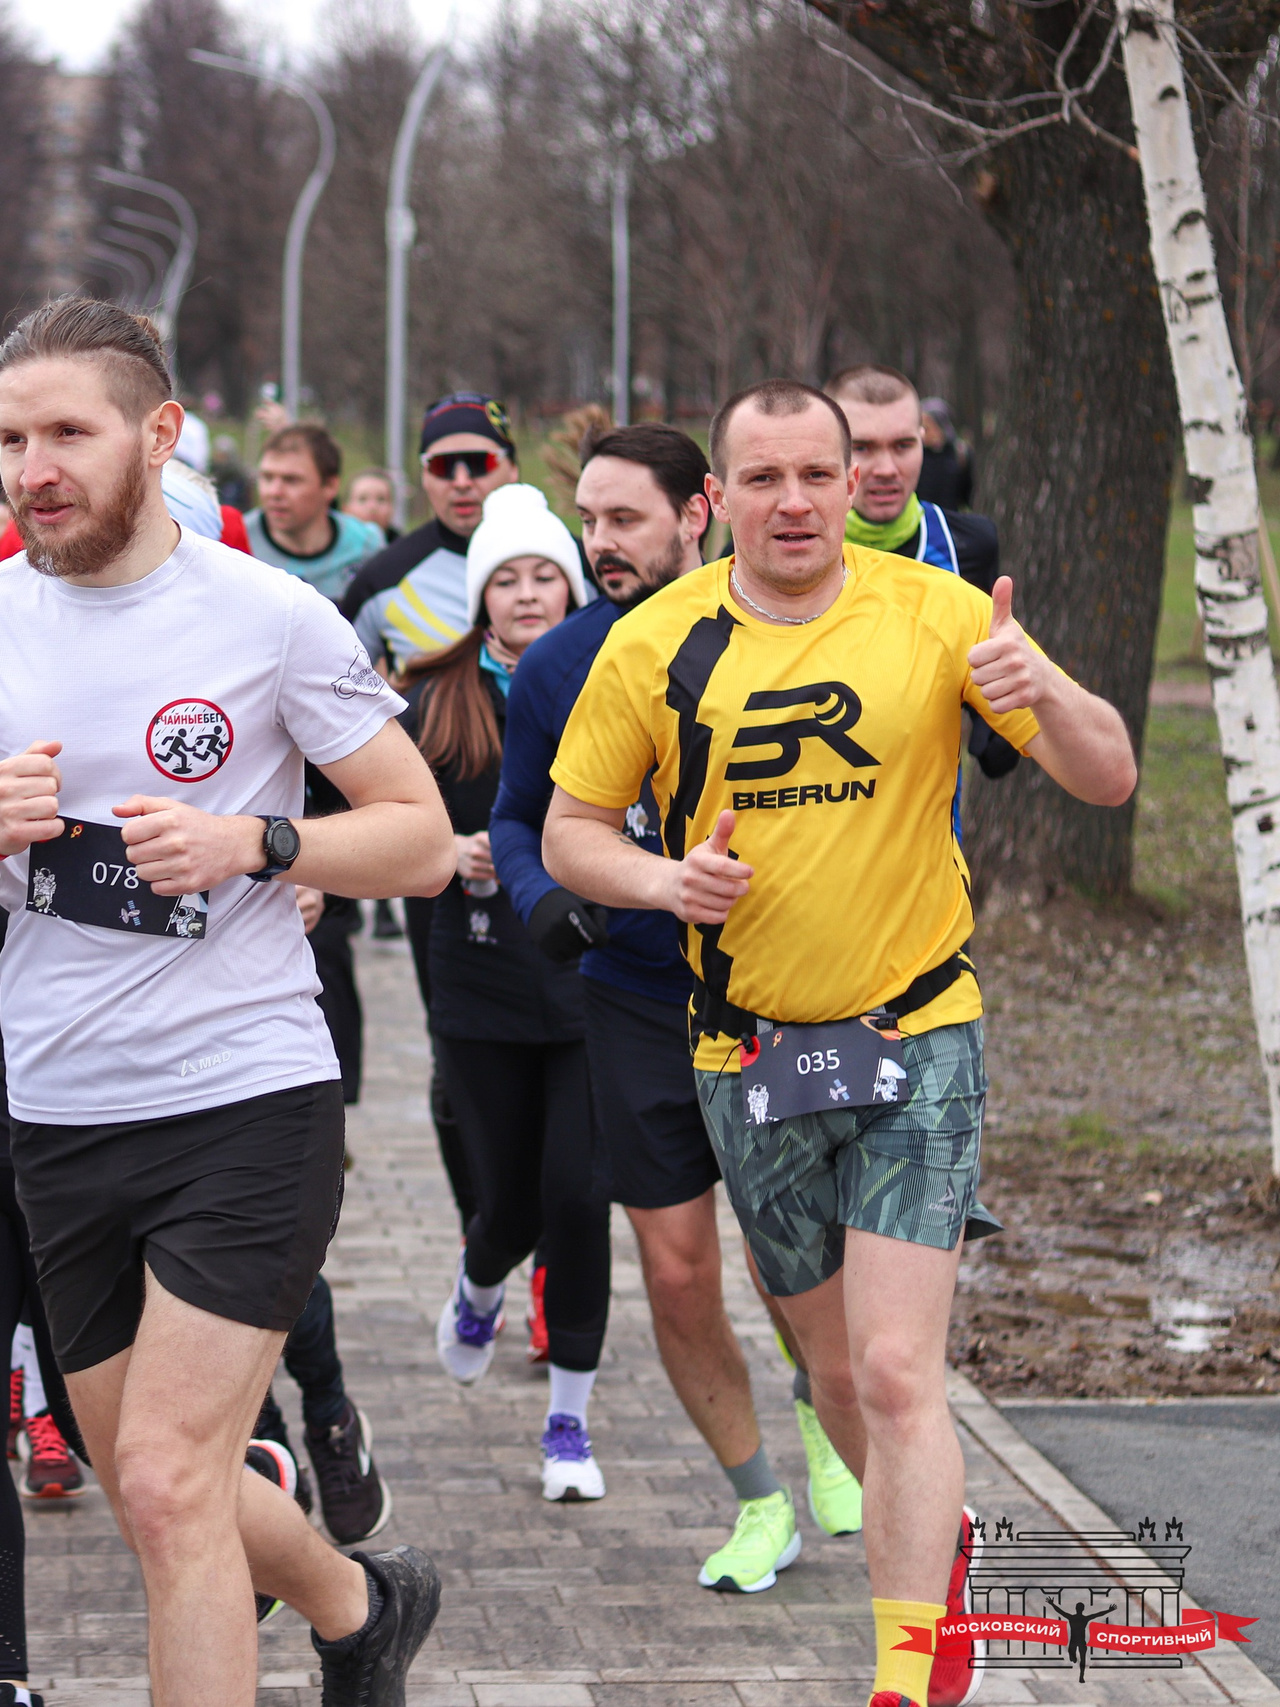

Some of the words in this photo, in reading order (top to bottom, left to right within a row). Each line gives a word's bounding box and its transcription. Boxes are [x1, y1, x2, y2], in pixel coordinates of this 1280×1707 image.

[732, 779, 877, 811] BEERUN
[92, 861, 140, 890] 078
[796, 1048, 841, 1075] 035
